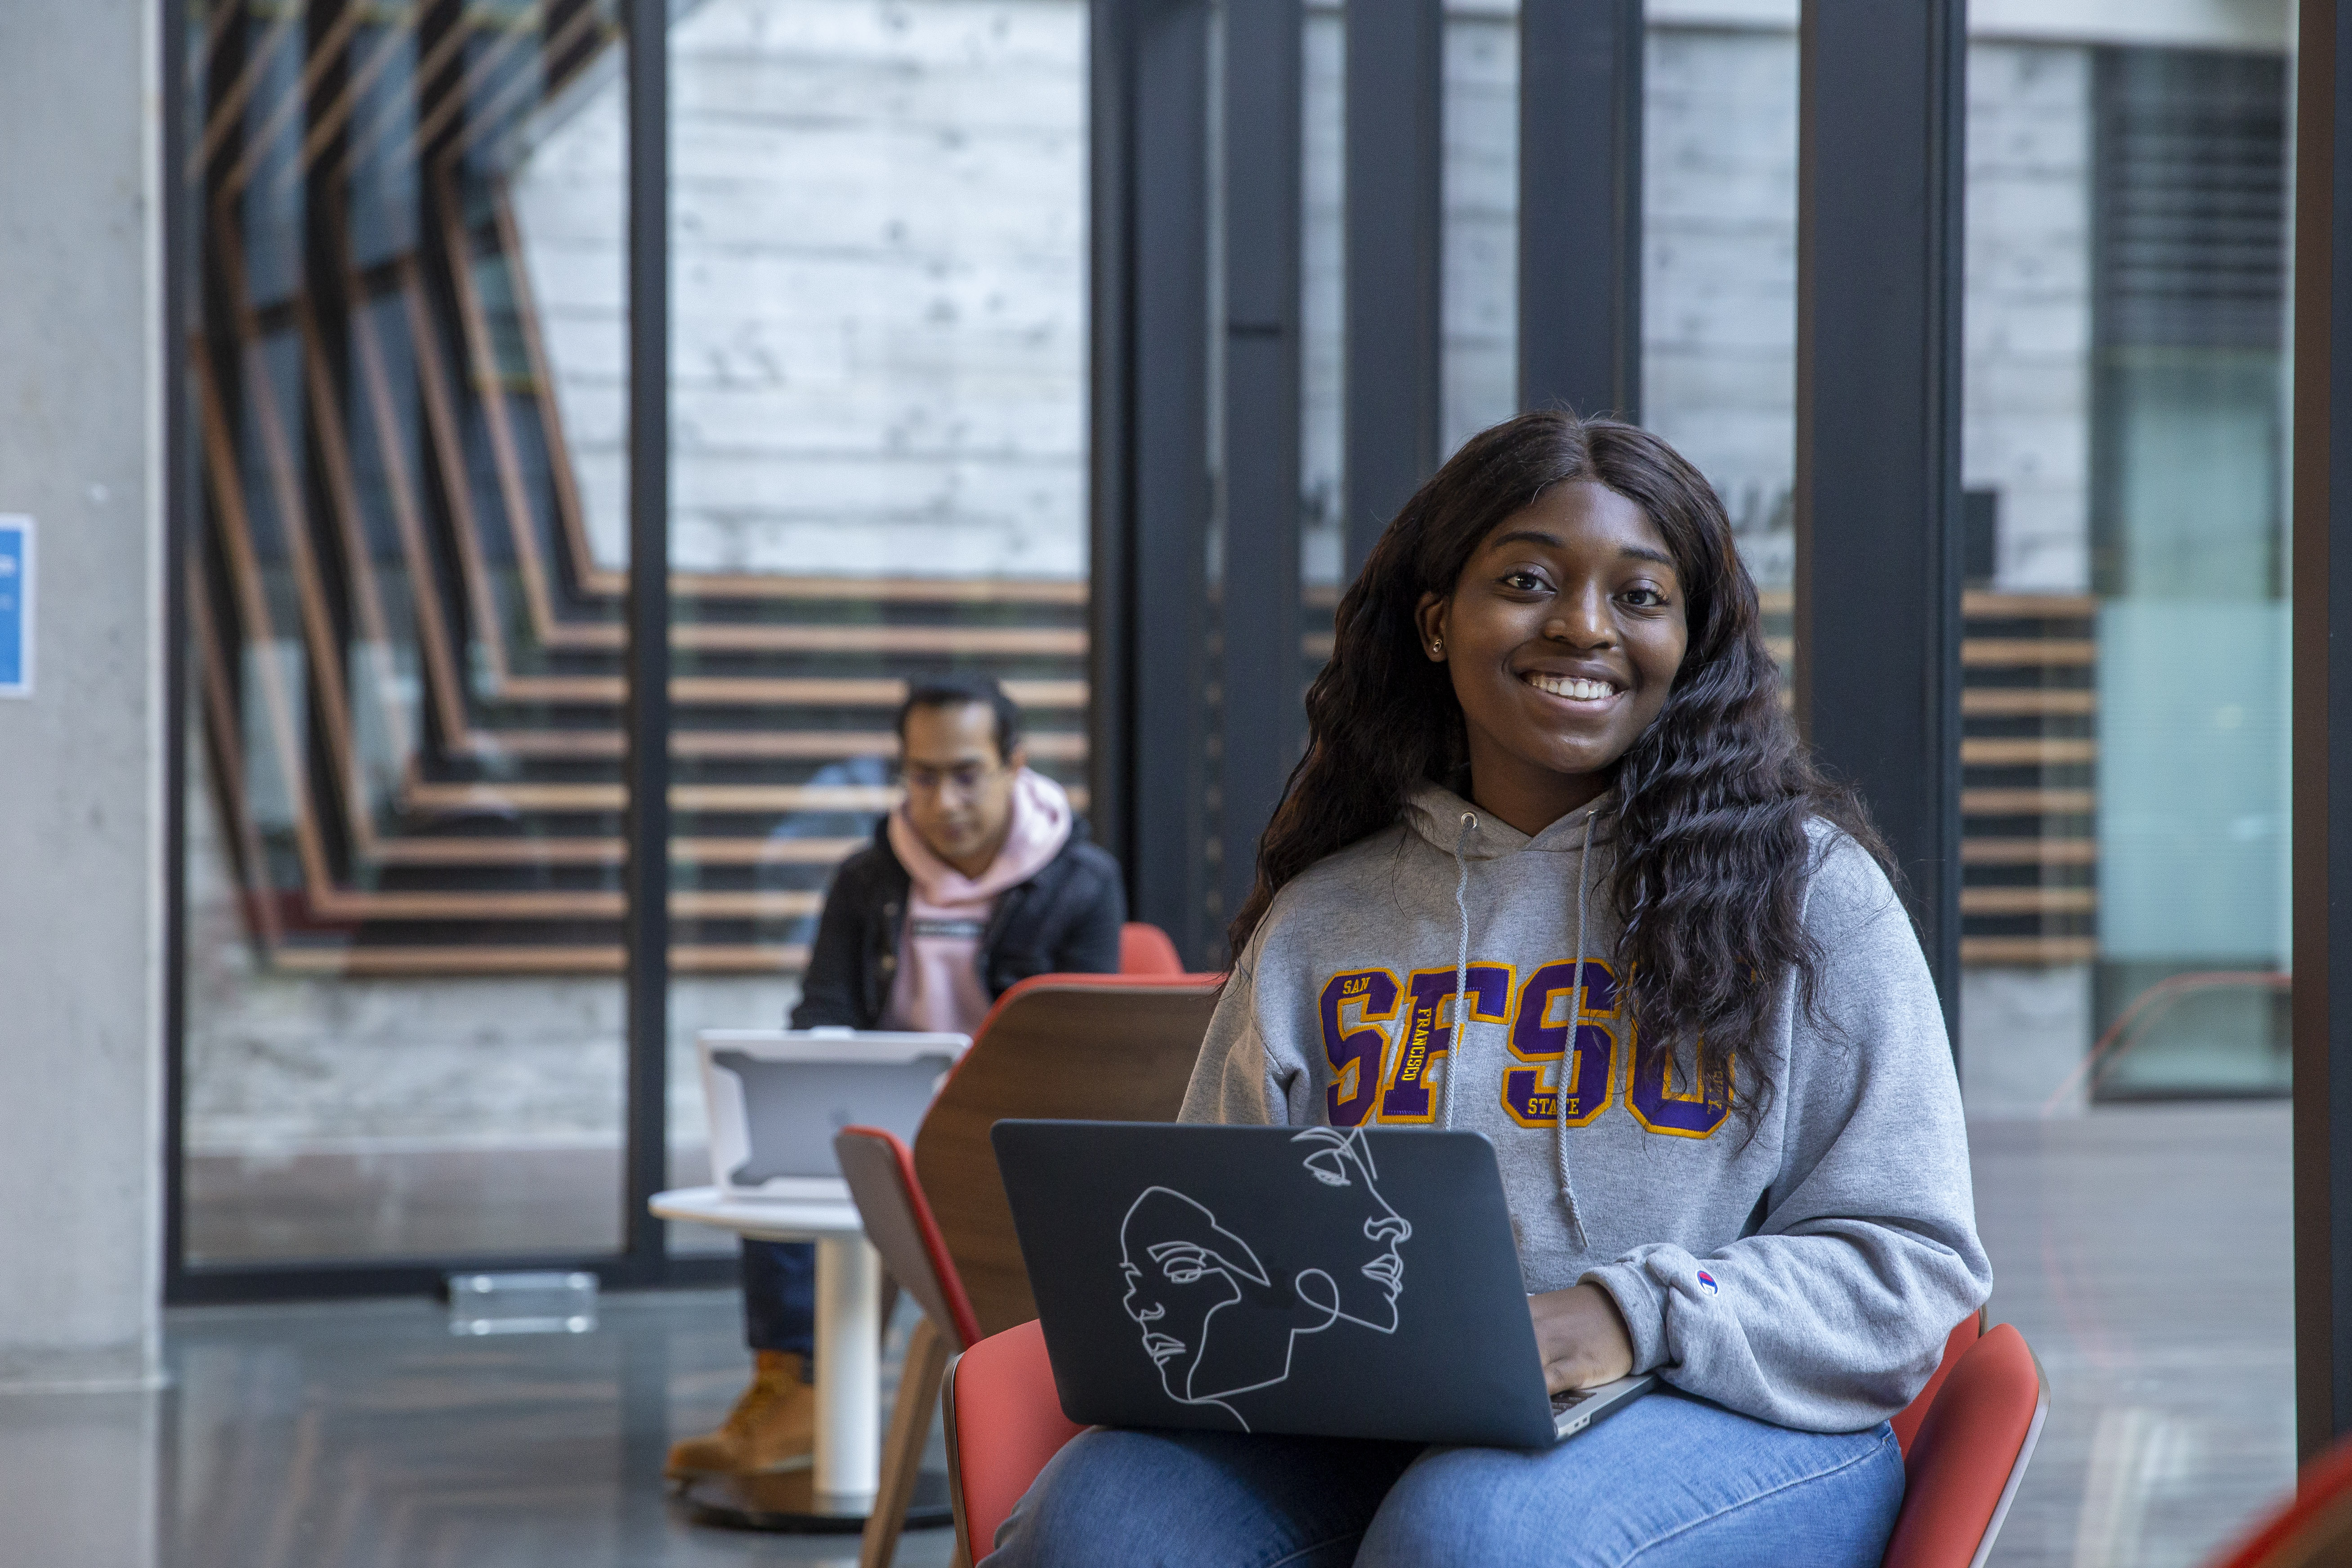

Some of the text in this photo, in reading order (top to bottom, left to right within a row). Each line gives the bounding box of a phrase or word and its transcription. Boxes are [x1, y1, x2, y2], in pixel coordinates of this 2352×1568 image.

[1343, 977, 1371, 994] SAN
[1401, 1008, 1432, 1081] FRANCISCO
[1528, 1098, 1579, 1115] STAE
